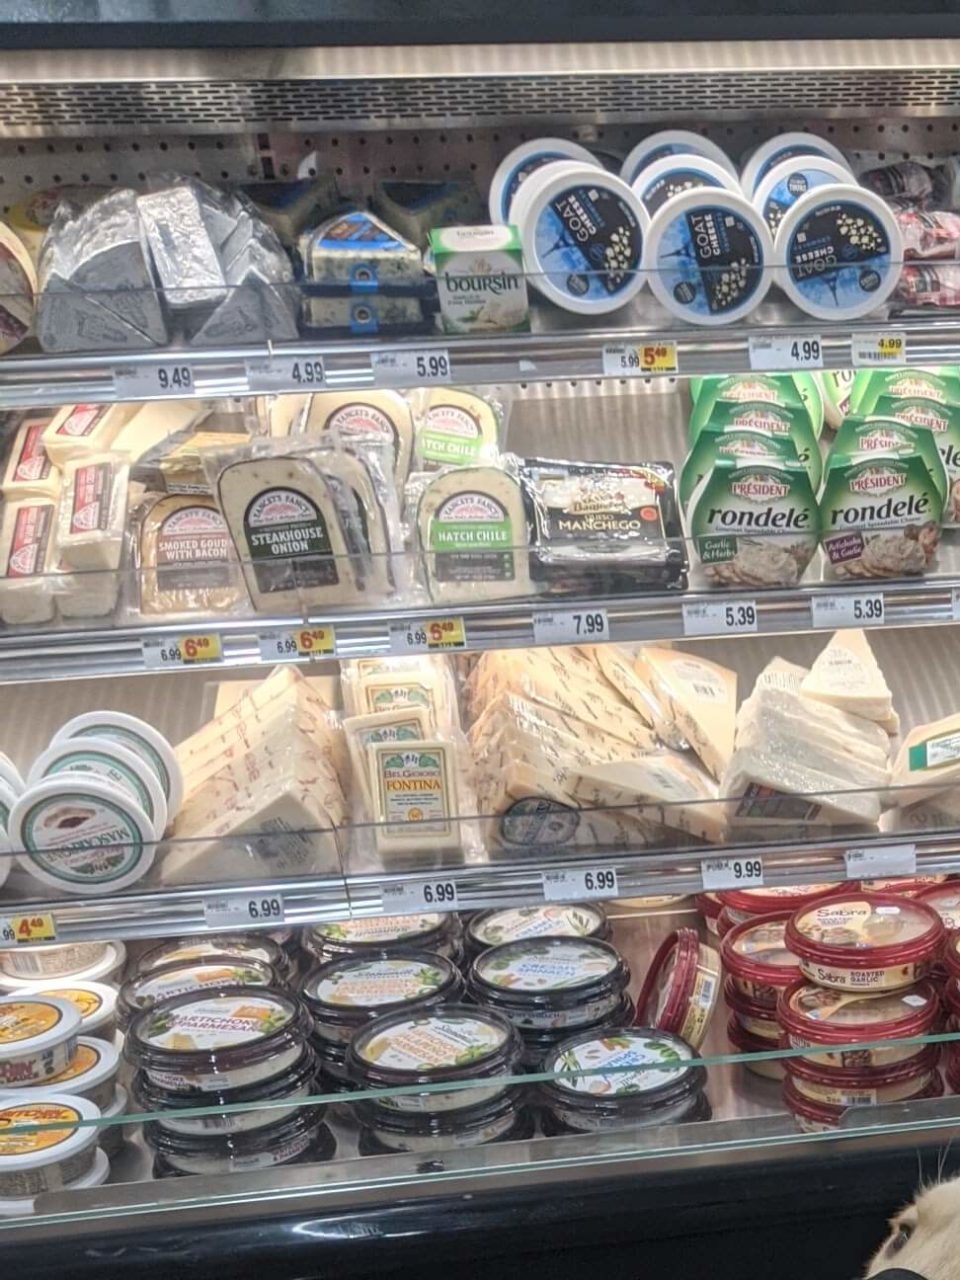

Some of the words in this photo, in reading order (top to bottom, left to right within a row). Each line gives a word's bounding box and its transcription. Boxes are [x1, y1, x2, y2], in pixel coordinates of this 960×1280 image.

[555, 200, 589, 242] GOAT
[567, 194, 597, 235] CHEESE
[691, 214, 712, 258] GOAT
[704, 213, 721, 256] CHEESE
[797, 254, 837, 278] GOAT
[790, 340, 820, 362] 4.99
[878, 338, 902, 350] 4.99
[291, 358, 324, 382] 4.99
[416, 349, 448, 376] 5.99
[620, 355, 640, 368] 5.99
[157, 366, 192, 388] 9.49
[733, 481, 788, 497] PRÉSIDENT
[851, 475, 904, 491] PRÉSIDENT
[707, 506, 810, 529] rondelé
[830, 491, 929, 525] rondelé
[558, 519, 641, 531] MANCHEGO
[250, 526, 324, 546] STEAKHOUSE
[437, 530, 474, 542] HATCH
[476, 529, 507, 541] CHILE
[158, 540, 198, 552] SMOKED
[166, 549, 193, 560] WITH
[195, 547, 227, 559] BACON
[270, 540, 309, 555] ONION
[725, 605, 755, 626] 5.39
[854, 598, 883, 618] 5.39
[572, 613, 604, 636] 7.99
[276, 640, 298, 654] 6.99
[407, 632, 428, 646] 6.99
[160, 648, 182, 662] 6.99
[386, 778, 442, 792] FONTINA
[733, 861, 762, 878] 9.99
[584, 870, 615, 891] 6.99
[423, 882, 455, 903] 6.99
[248, 899, 281, 919] 6.99
[817, 908, 867, 918] Sabra
[818, 968, 846, 984] Sabra
[850, 970, 884, 978] ROASTED
